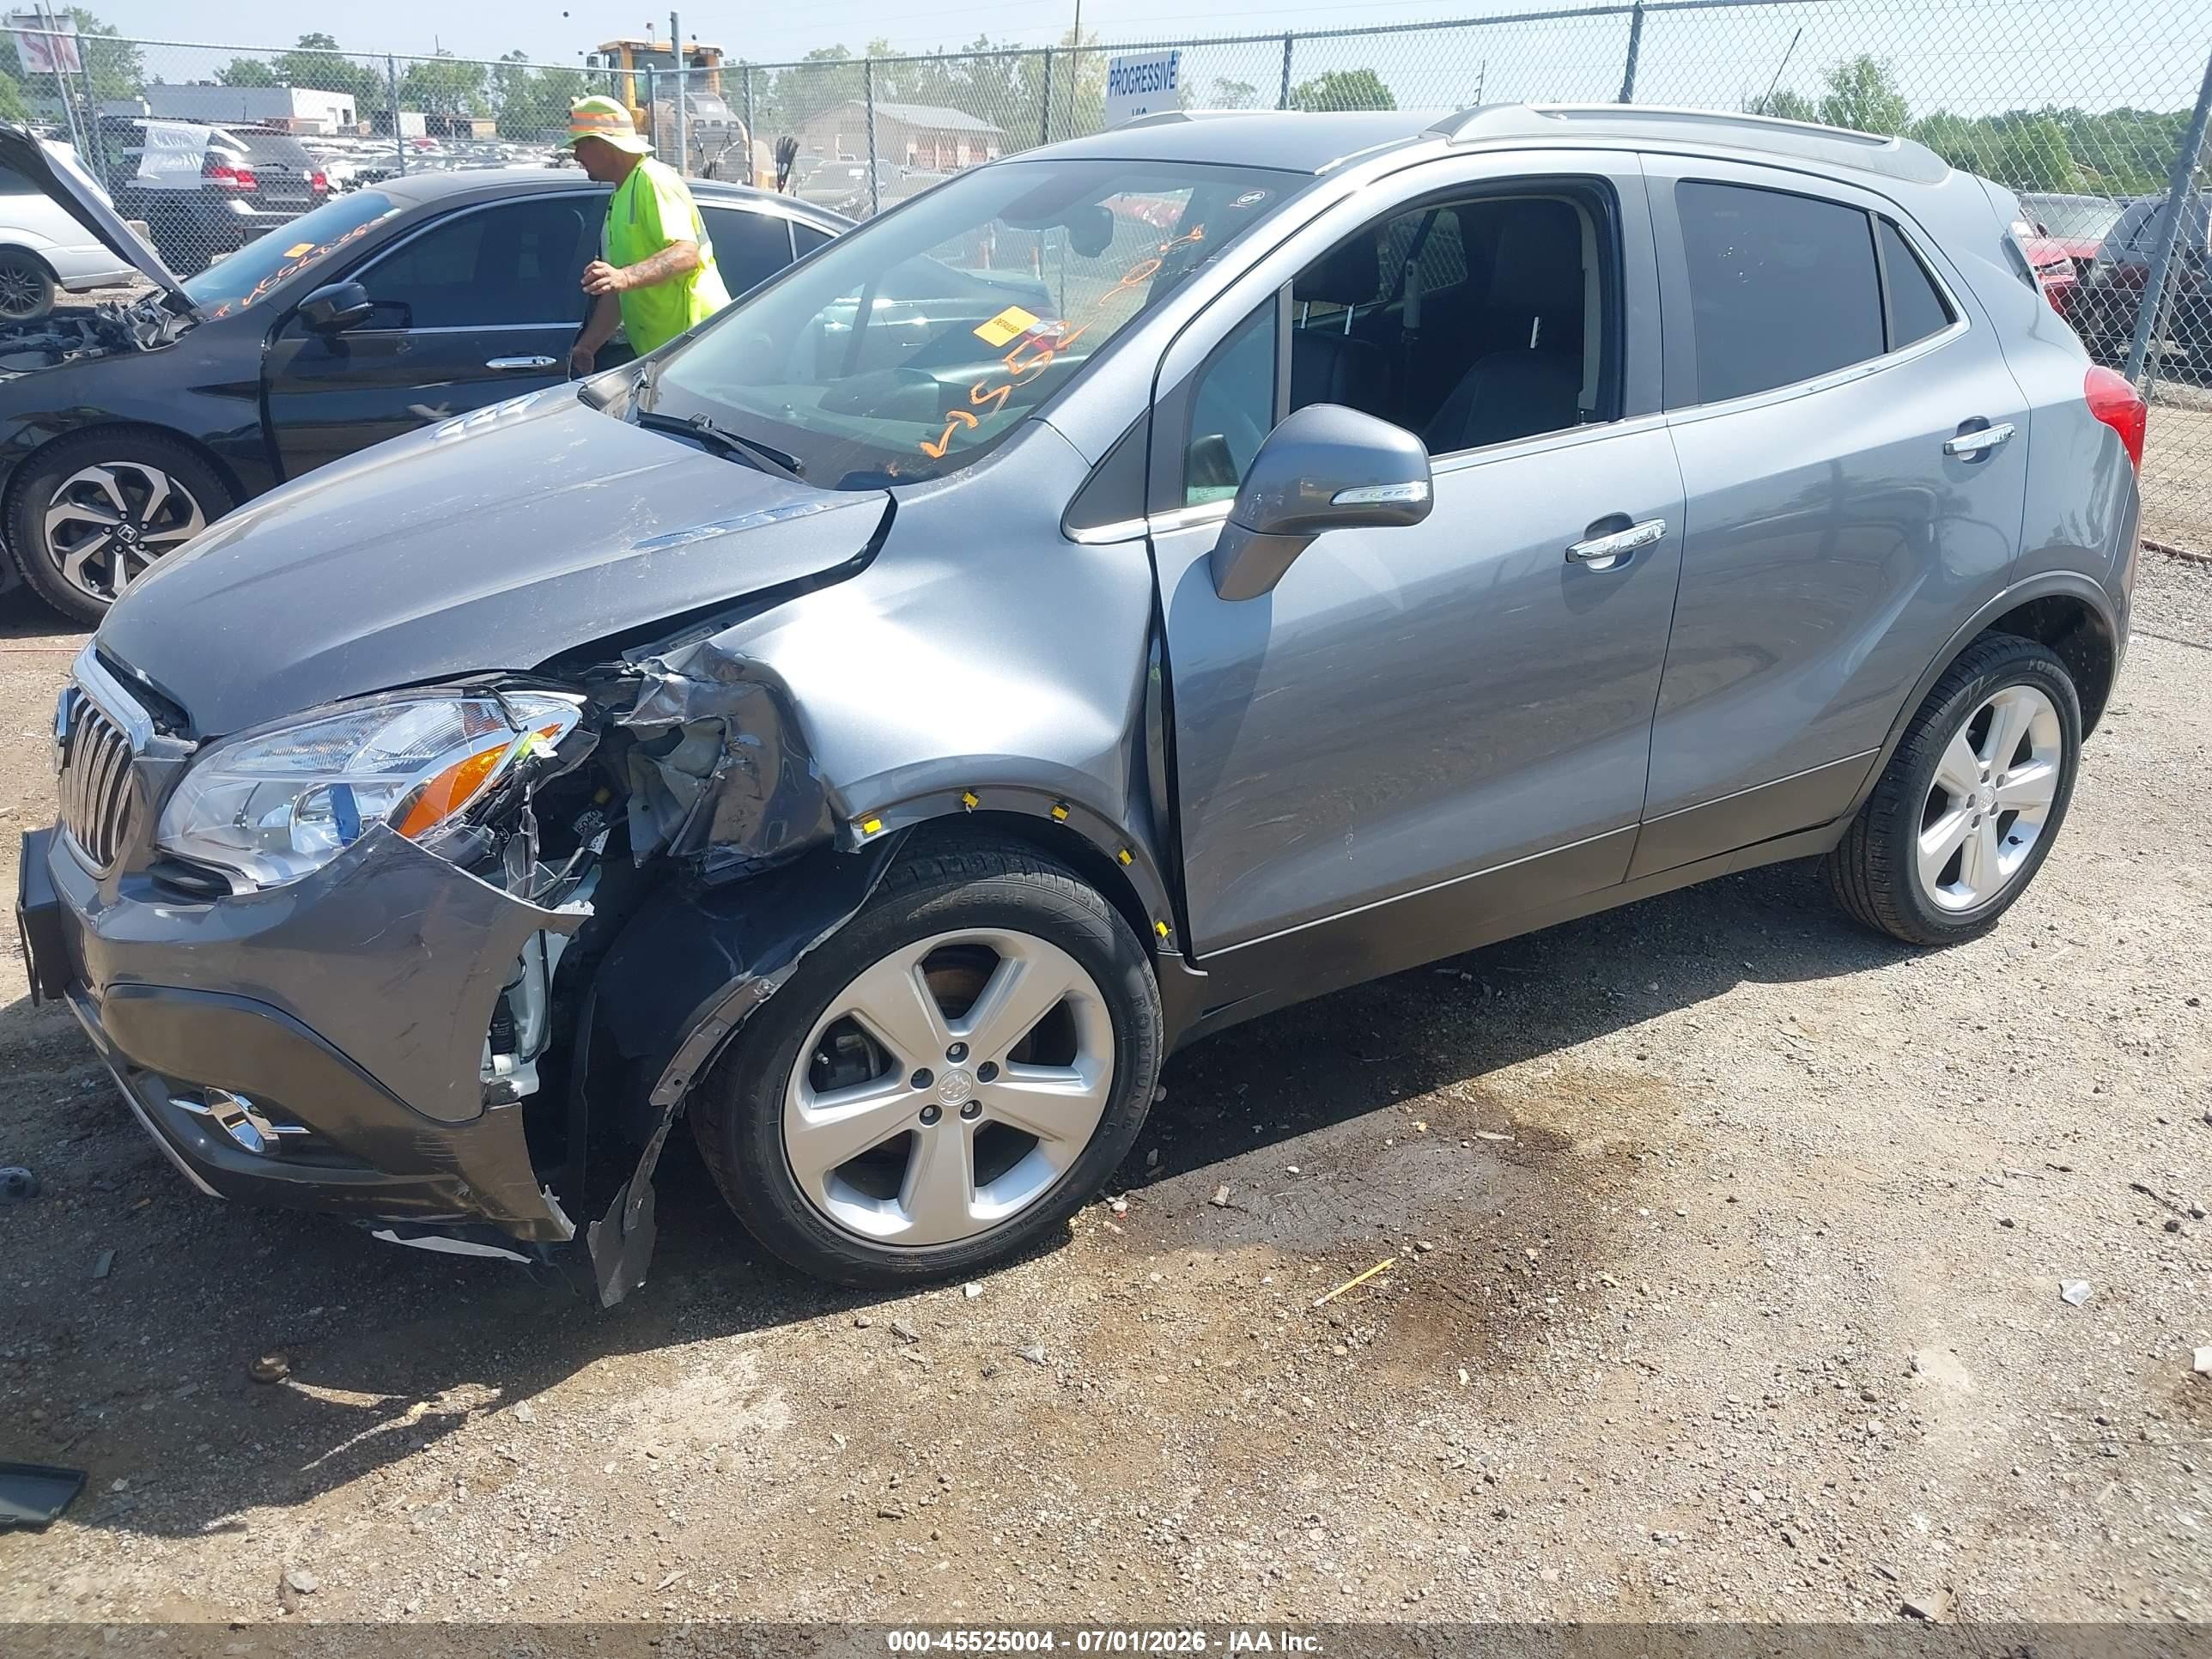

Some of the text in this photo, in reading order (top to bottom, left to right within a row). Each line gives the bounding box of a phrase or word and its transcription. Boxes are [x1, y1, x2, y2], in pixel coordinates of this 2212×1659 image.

[1109, 59, 1176, 97] PROGRESSIVE
[992, 317, 1020, 334] DETAILED
[1122, 991, 1152, 1130] FORTUNE
